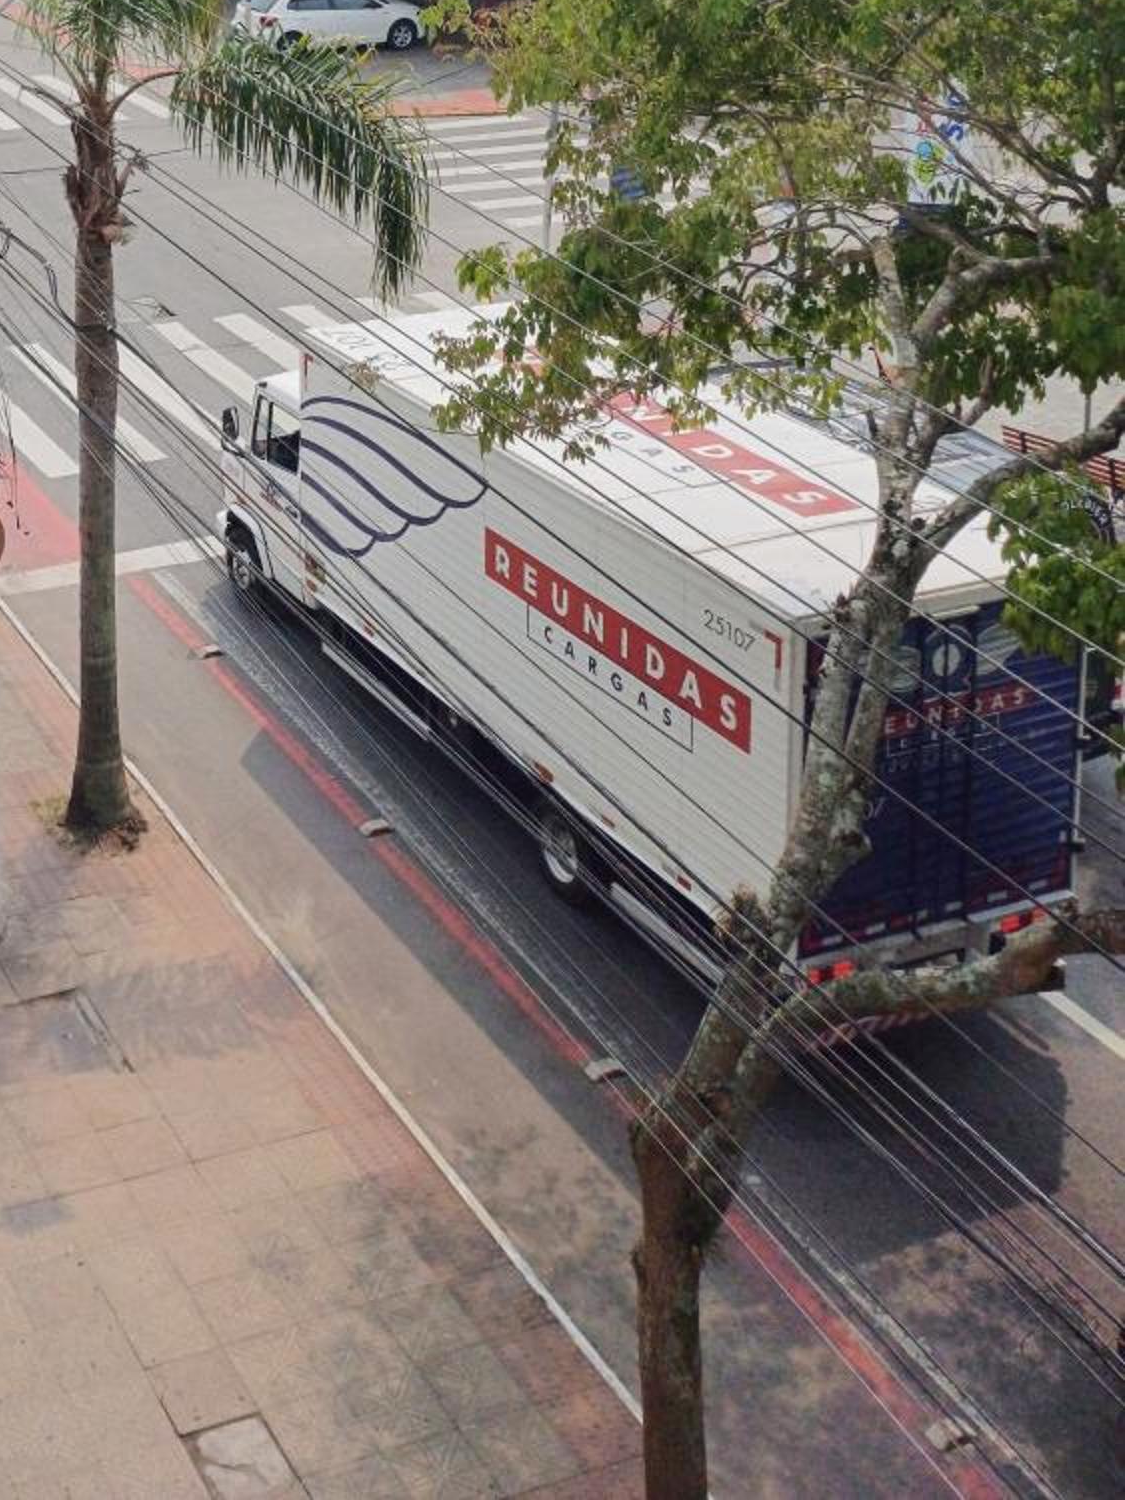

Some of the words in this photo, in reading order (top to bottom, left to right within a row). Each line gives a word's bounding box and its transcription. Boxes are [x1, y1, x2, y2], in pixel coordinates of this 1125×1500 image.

[494, 544, 738, 731] REUNIDAS
[703, 608, 757, 652] 25107
[544, 626, 673, 727] CARGAS
[884, 687, 1026, 735] EUNIDAS
